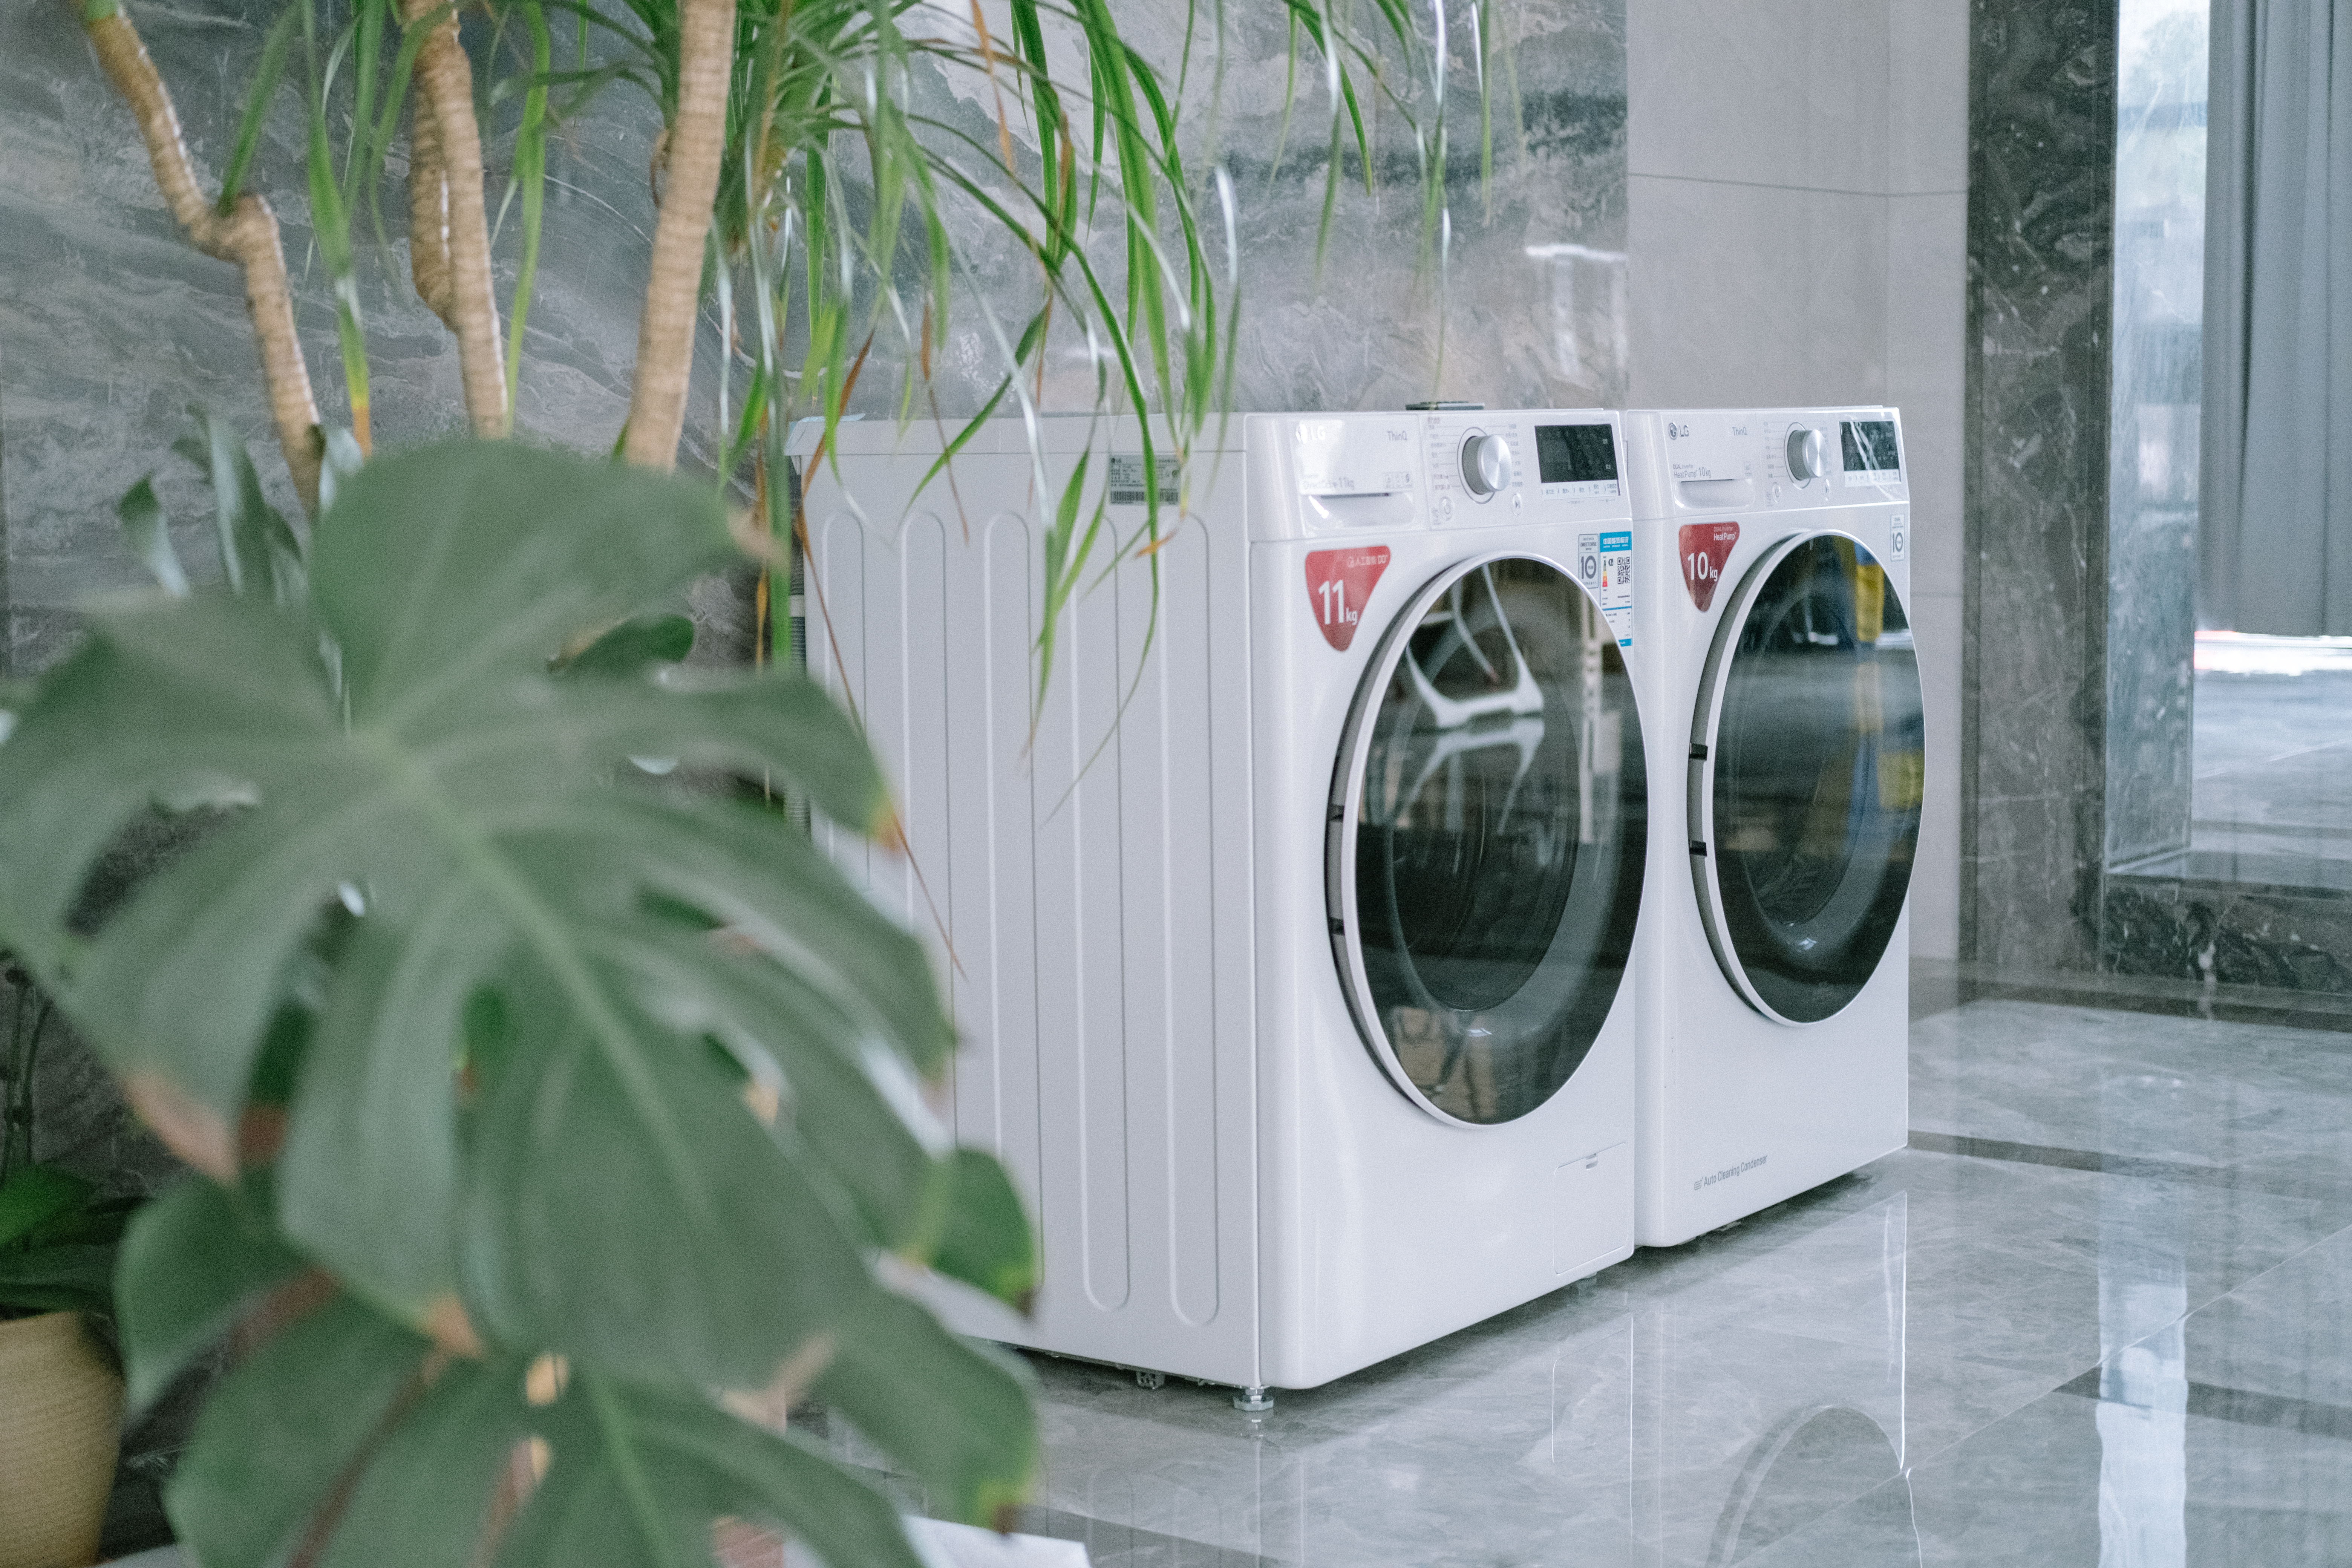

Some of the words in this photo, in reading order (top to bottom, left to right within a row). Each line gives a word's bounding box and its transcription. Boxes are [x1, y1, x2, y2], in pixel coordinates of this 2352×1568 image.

[1310, 425, 1325, 441] LG
[1387, 430, 1407, 441] ThinQ
[1679, 425, 1689, 437] LG
[1732, 426, 1747, 436] ThinQ
[1893, 532, 1903, 552] 10
[1581, 555, 1596, 579] 10
[1704, 1175, 1717, 1187] Auto
[1718, 1165, 1740, 1181] Cleaning
[1741, 1155, 1767, 1172] Condenser
